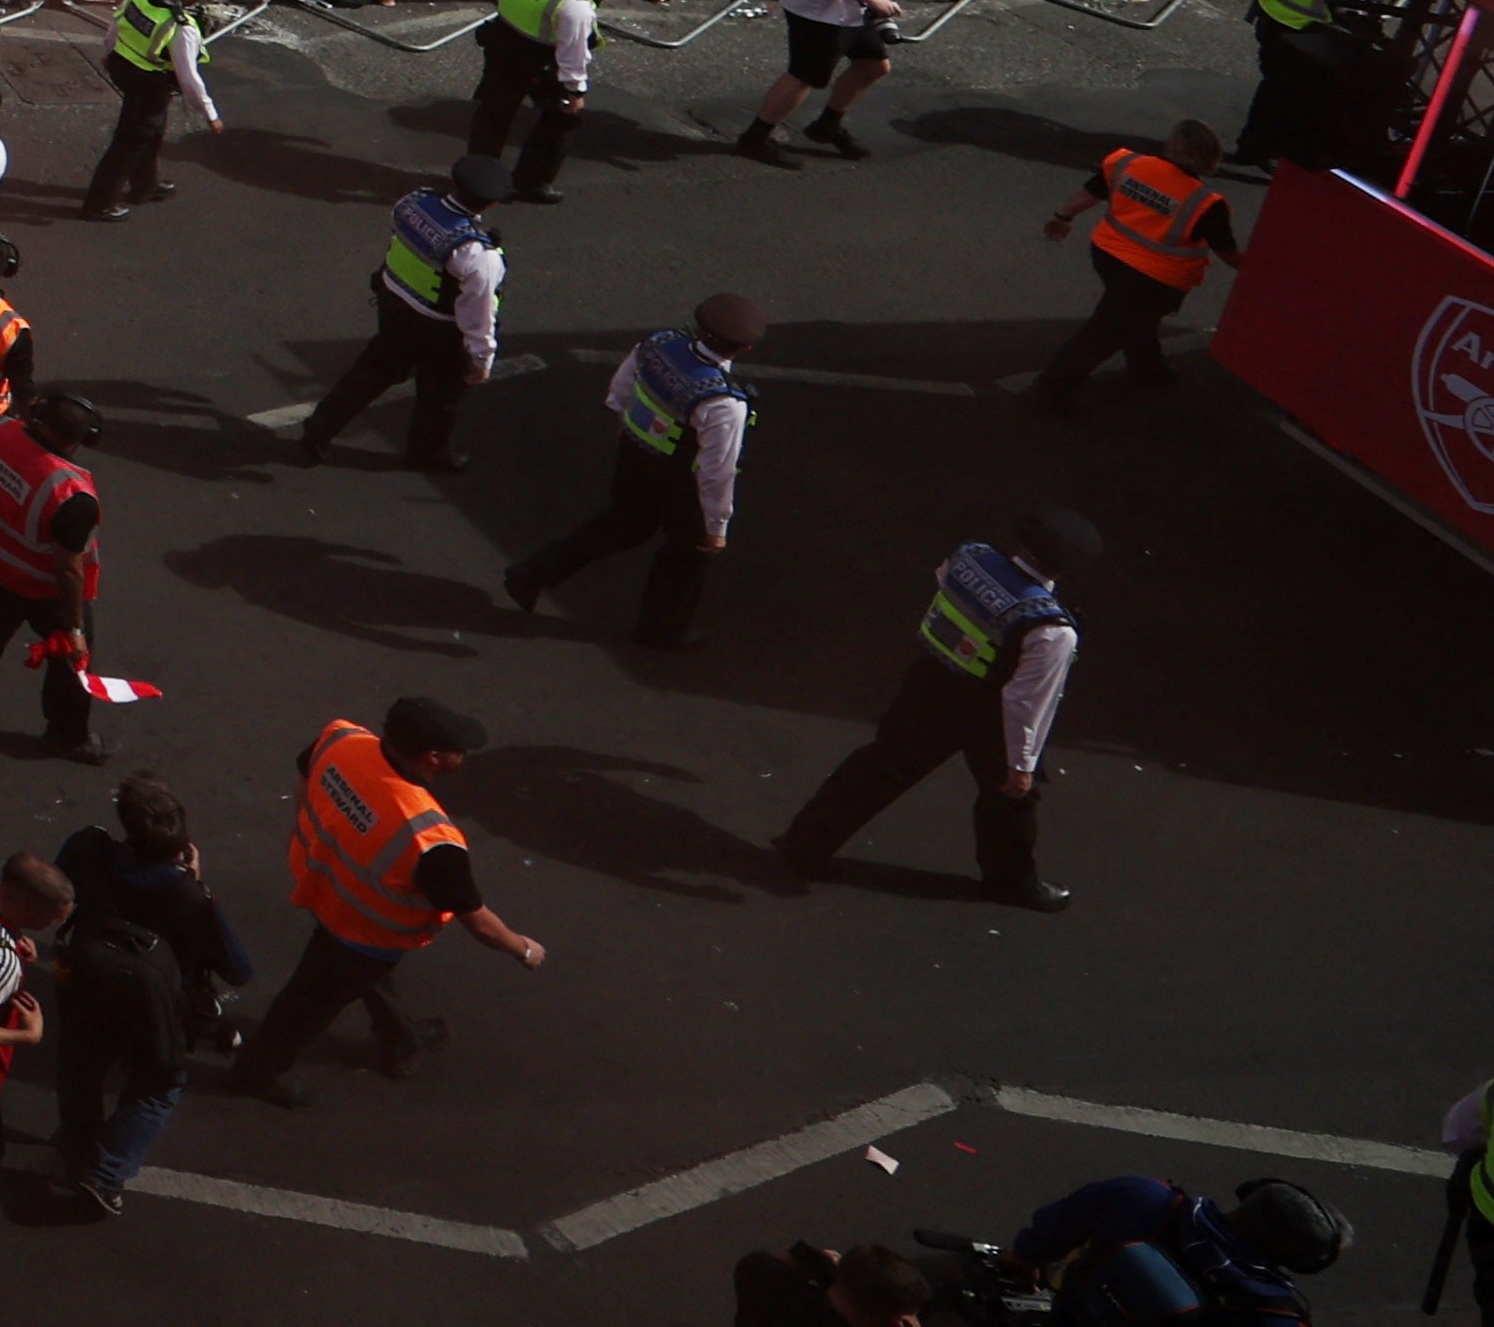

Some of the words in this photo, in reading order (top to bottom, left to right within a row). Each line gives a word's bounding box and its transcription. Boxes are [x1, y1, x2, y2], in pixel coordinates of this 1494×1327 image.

[405, 206, 442, 247] POLICE
[956, 560, 1006, 610] POLICE
[322, 776, 367, 834] STEWARD
[327, 765, 374, 824] ARSENAL
